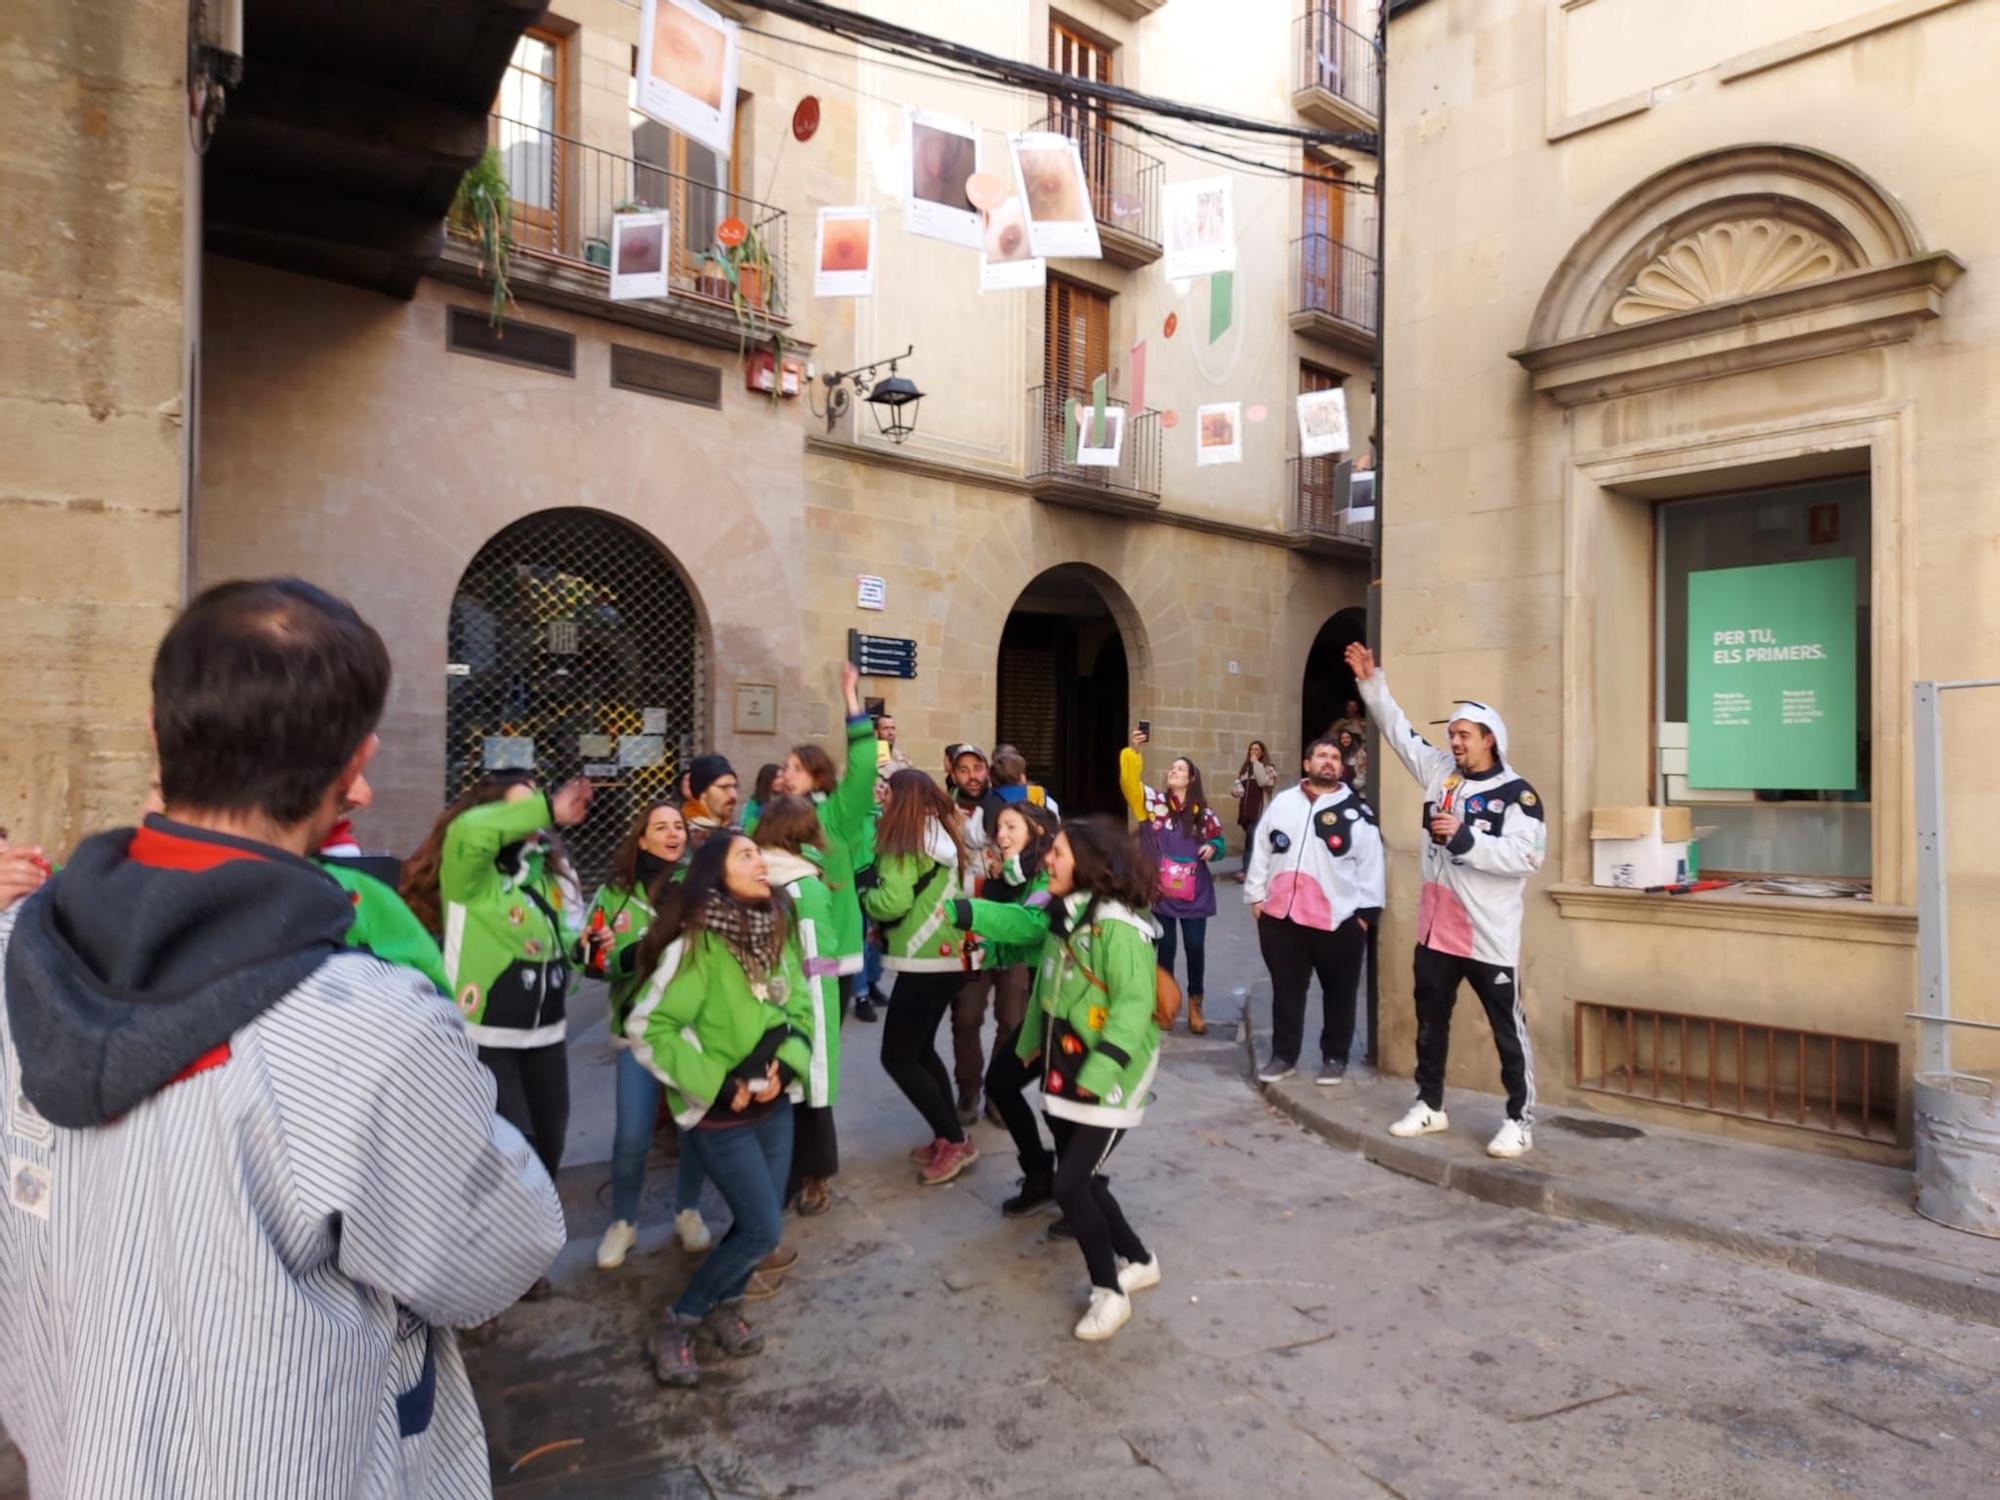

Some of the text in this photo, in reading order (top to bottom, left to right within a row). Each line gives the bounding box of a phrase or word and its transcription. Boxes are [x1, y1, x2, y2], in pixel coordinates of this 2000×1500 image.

[1713, 629, 1776, 646] PER TU,
[1713, 645, 1827, 664] ELS PRIMERS.
